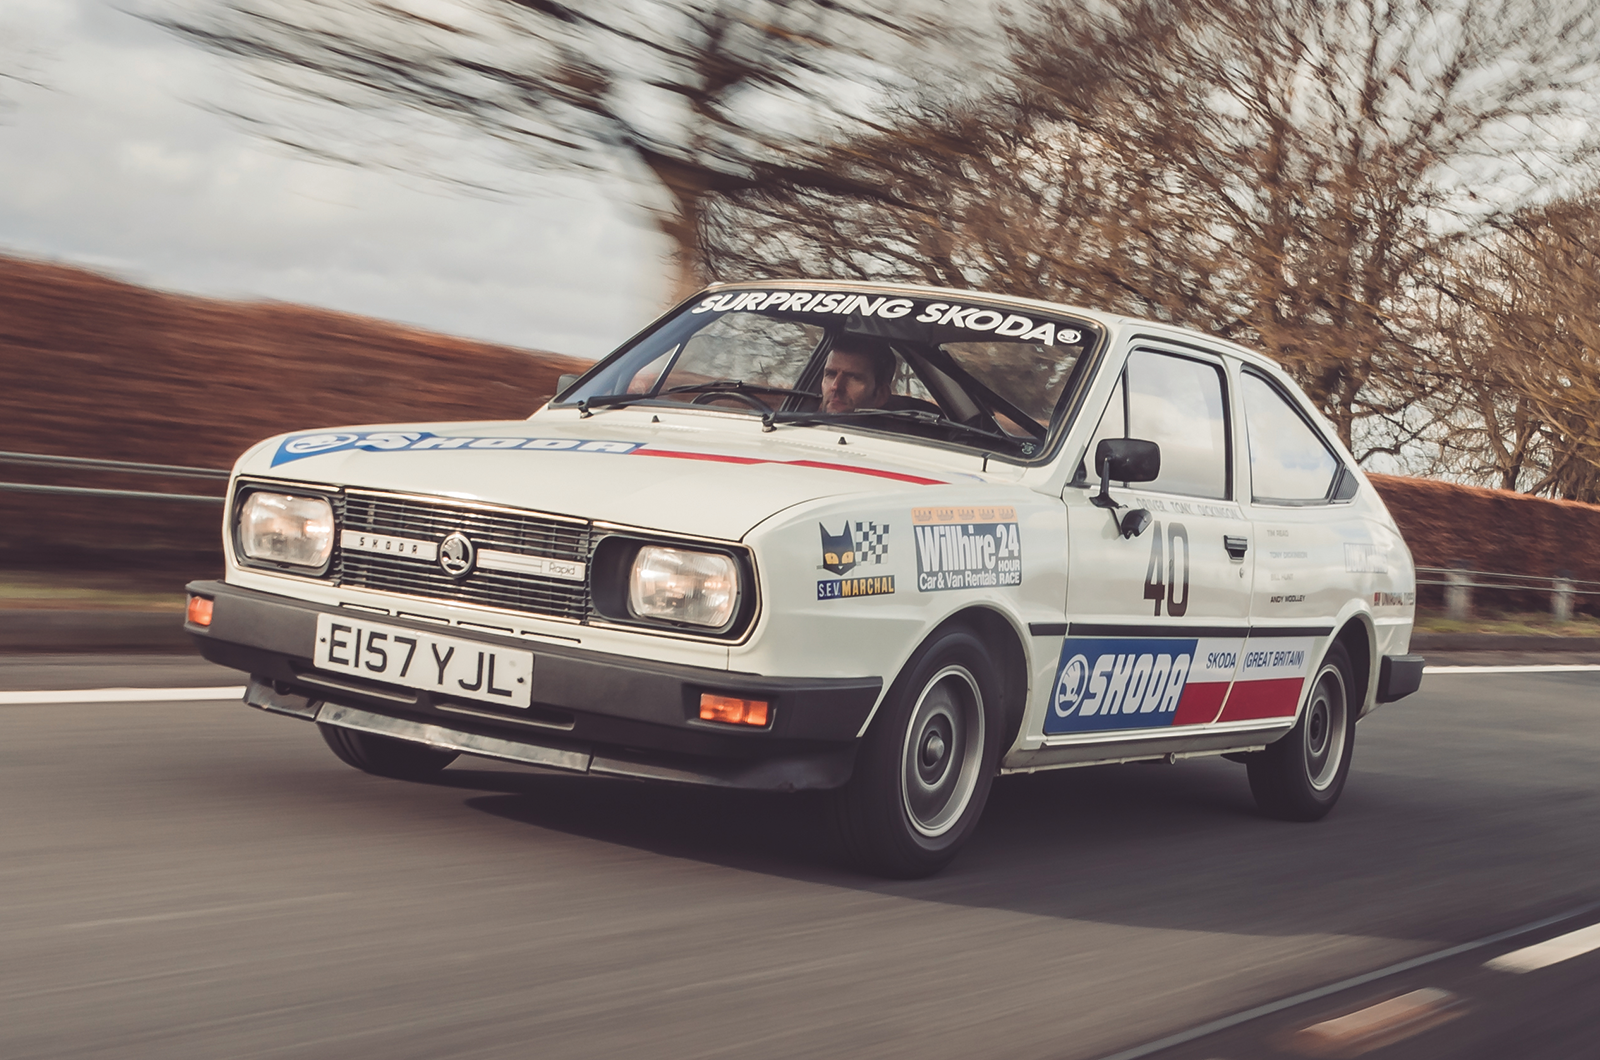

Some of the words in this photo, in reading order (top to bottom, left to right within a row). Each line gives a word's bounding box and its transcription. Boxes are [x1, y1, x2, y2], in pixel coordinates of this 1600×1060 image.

[692, 292, 914, 319] SURPRISING
[916, 303, 1055, 346] SKODA
[1170, 501, 1195, 516] TONY
[1197, 504, 1241, 520] DICKINSON
[358, 537, 418, 555] SKODA
[916, 524, 996, 572] Willhire
[996, 524, 1019, 557] 24
[548, 562, 576, 576] Rapid
[998, 560, 1020, 571] HOUR
[1143, 520, 1190, 617] 40
[841, 577, 894, 597] MARCHAL
[919, 574, 937, 590] Car
[937, 574, 945, 588] &
[946, 572, 963, 588] Van
[964, 570, 997, 587] Rentals
[998, 573, 1020, 584] RACE
[1270, 595, 1283, 603] ANDY
[328, 623, 417, 678] E157
[431, 643, 513, 698] YJL
[1205, 651, 1237, 670] SKODA
[1243, 651, 1273, 673] (GREAT
[1272, 650, 1304, 670] BRITAIN)
[1079, 652, 1192, 716] SKODA
